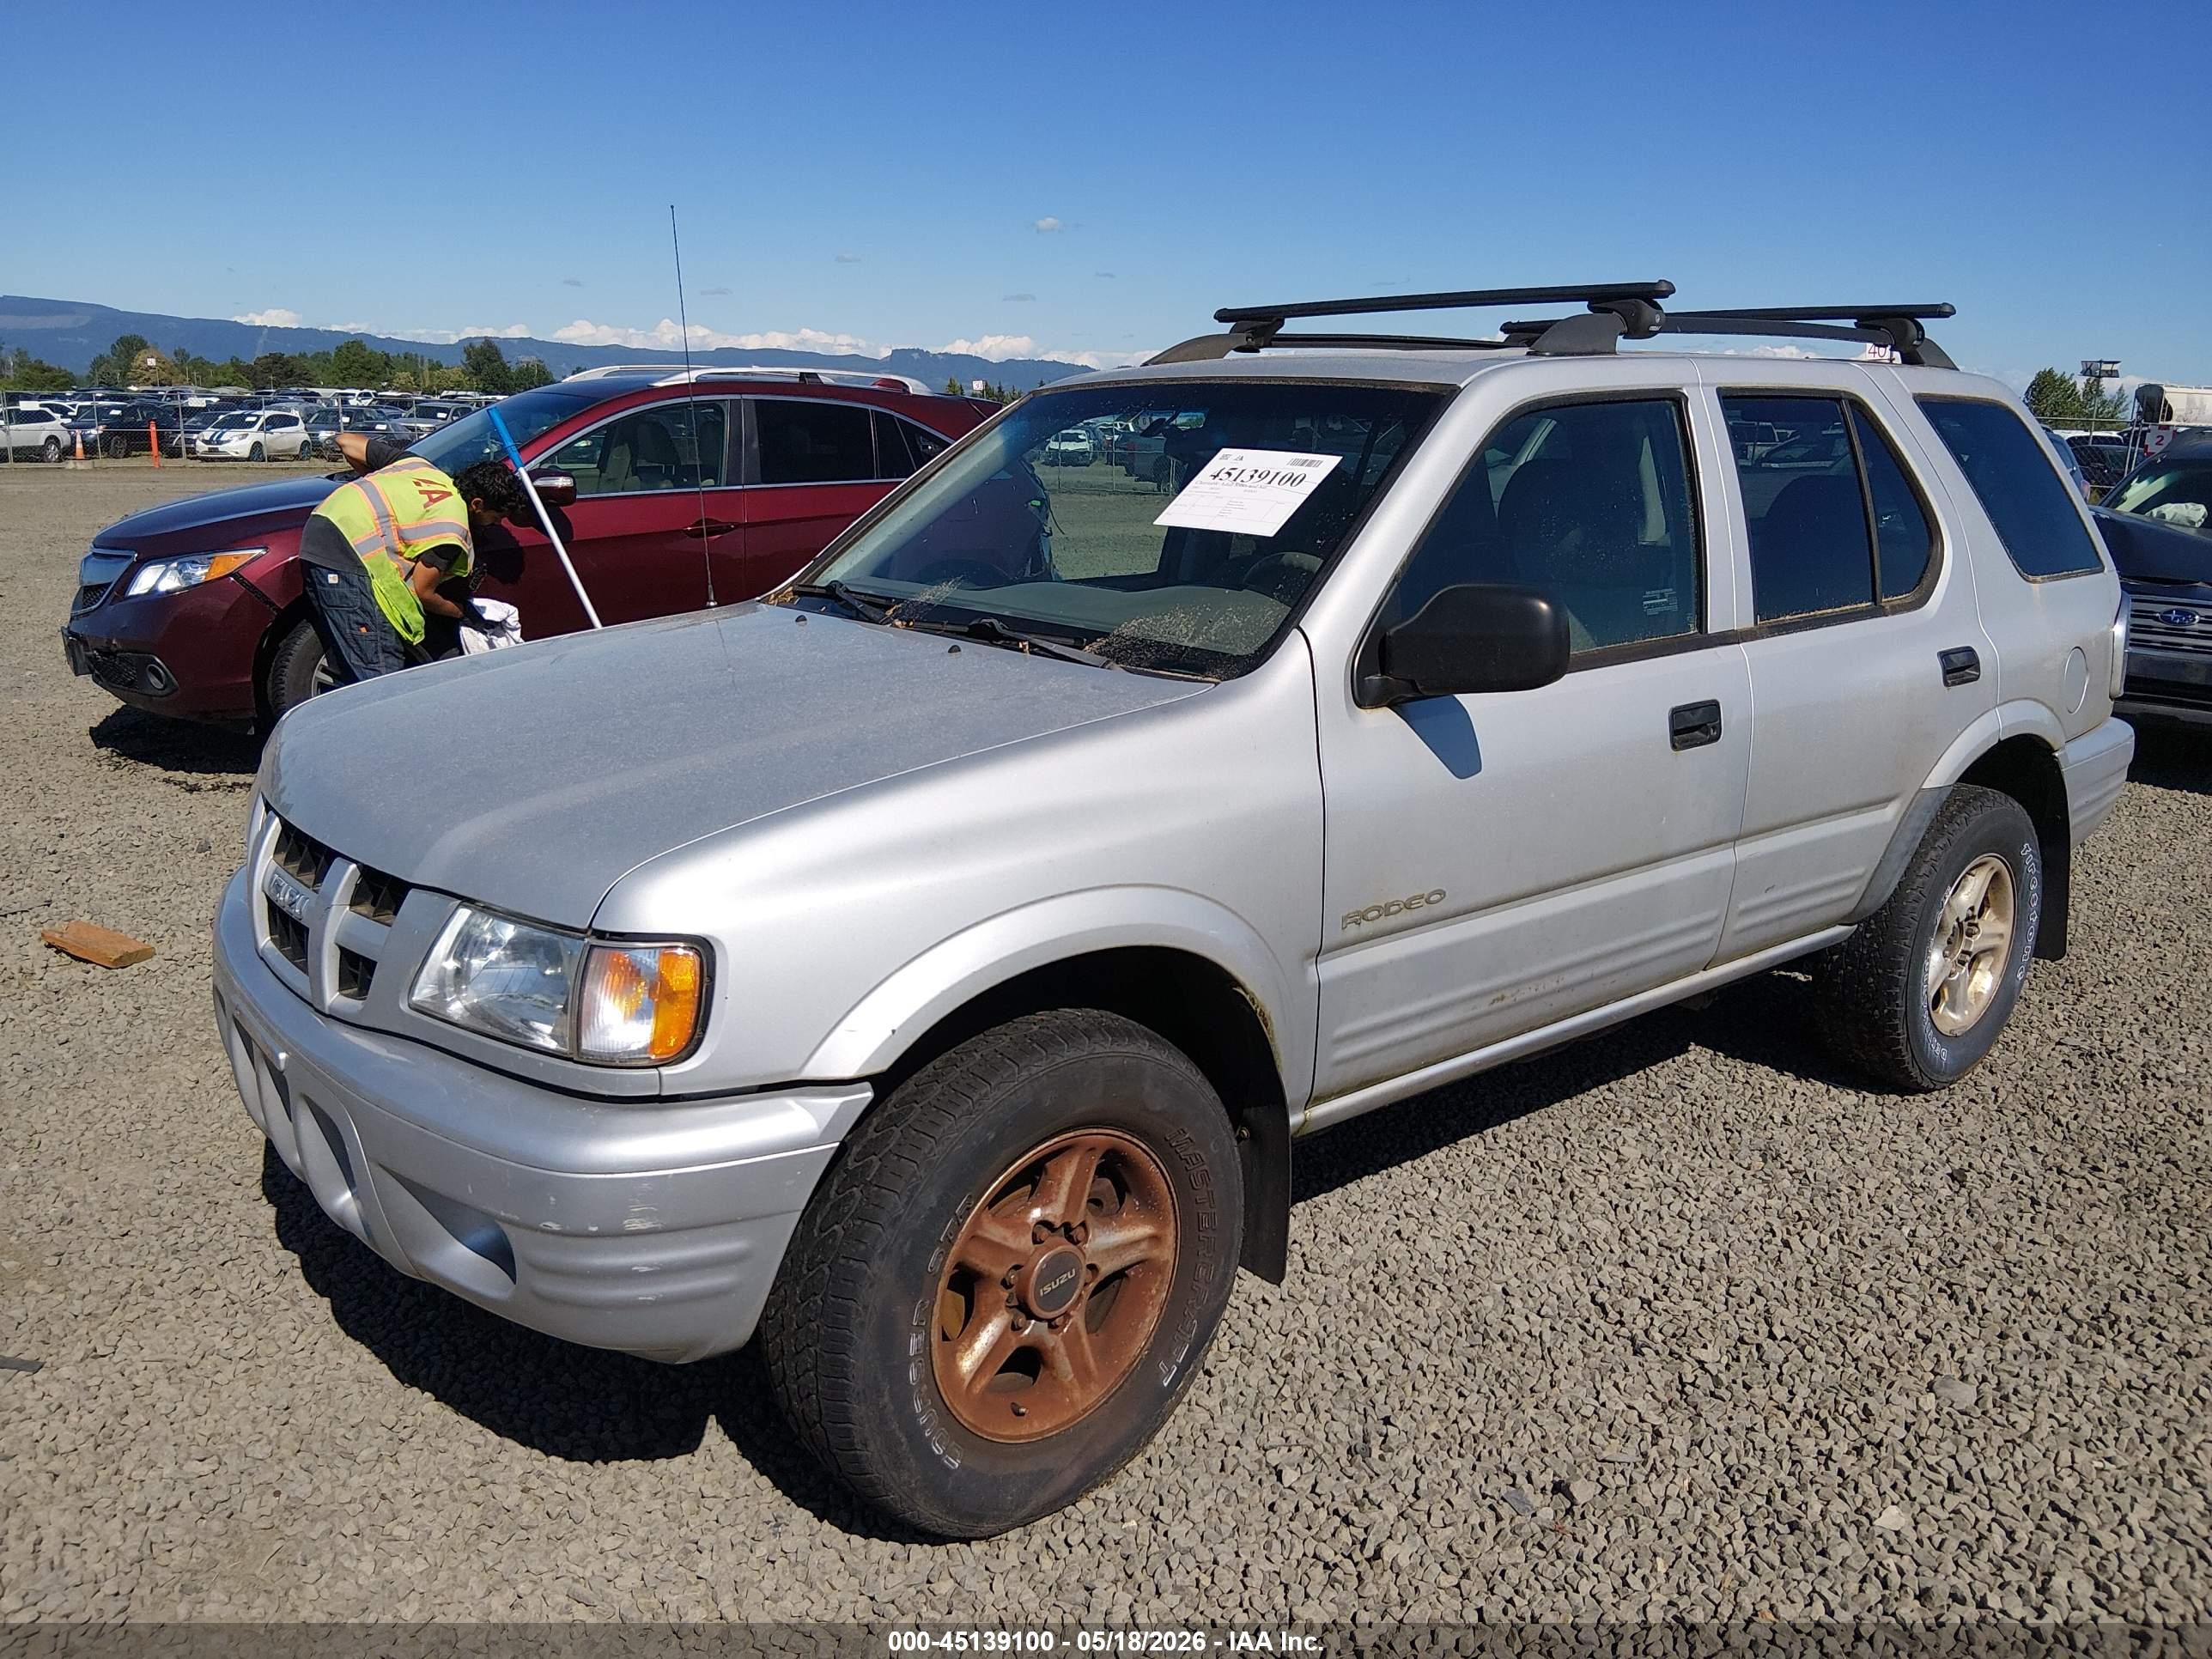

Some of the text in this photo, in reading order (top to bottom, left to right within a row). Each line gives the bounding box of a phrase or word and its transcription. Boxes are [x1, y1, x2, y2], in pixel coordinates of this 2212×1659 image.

[2155, 434, 2165, 446] 2
[1210, 467, 1307, 488] 45139100
[1340, 888, 1447, 930] RODEO
[1039, 1267, 1076, 1297] ISUZU
